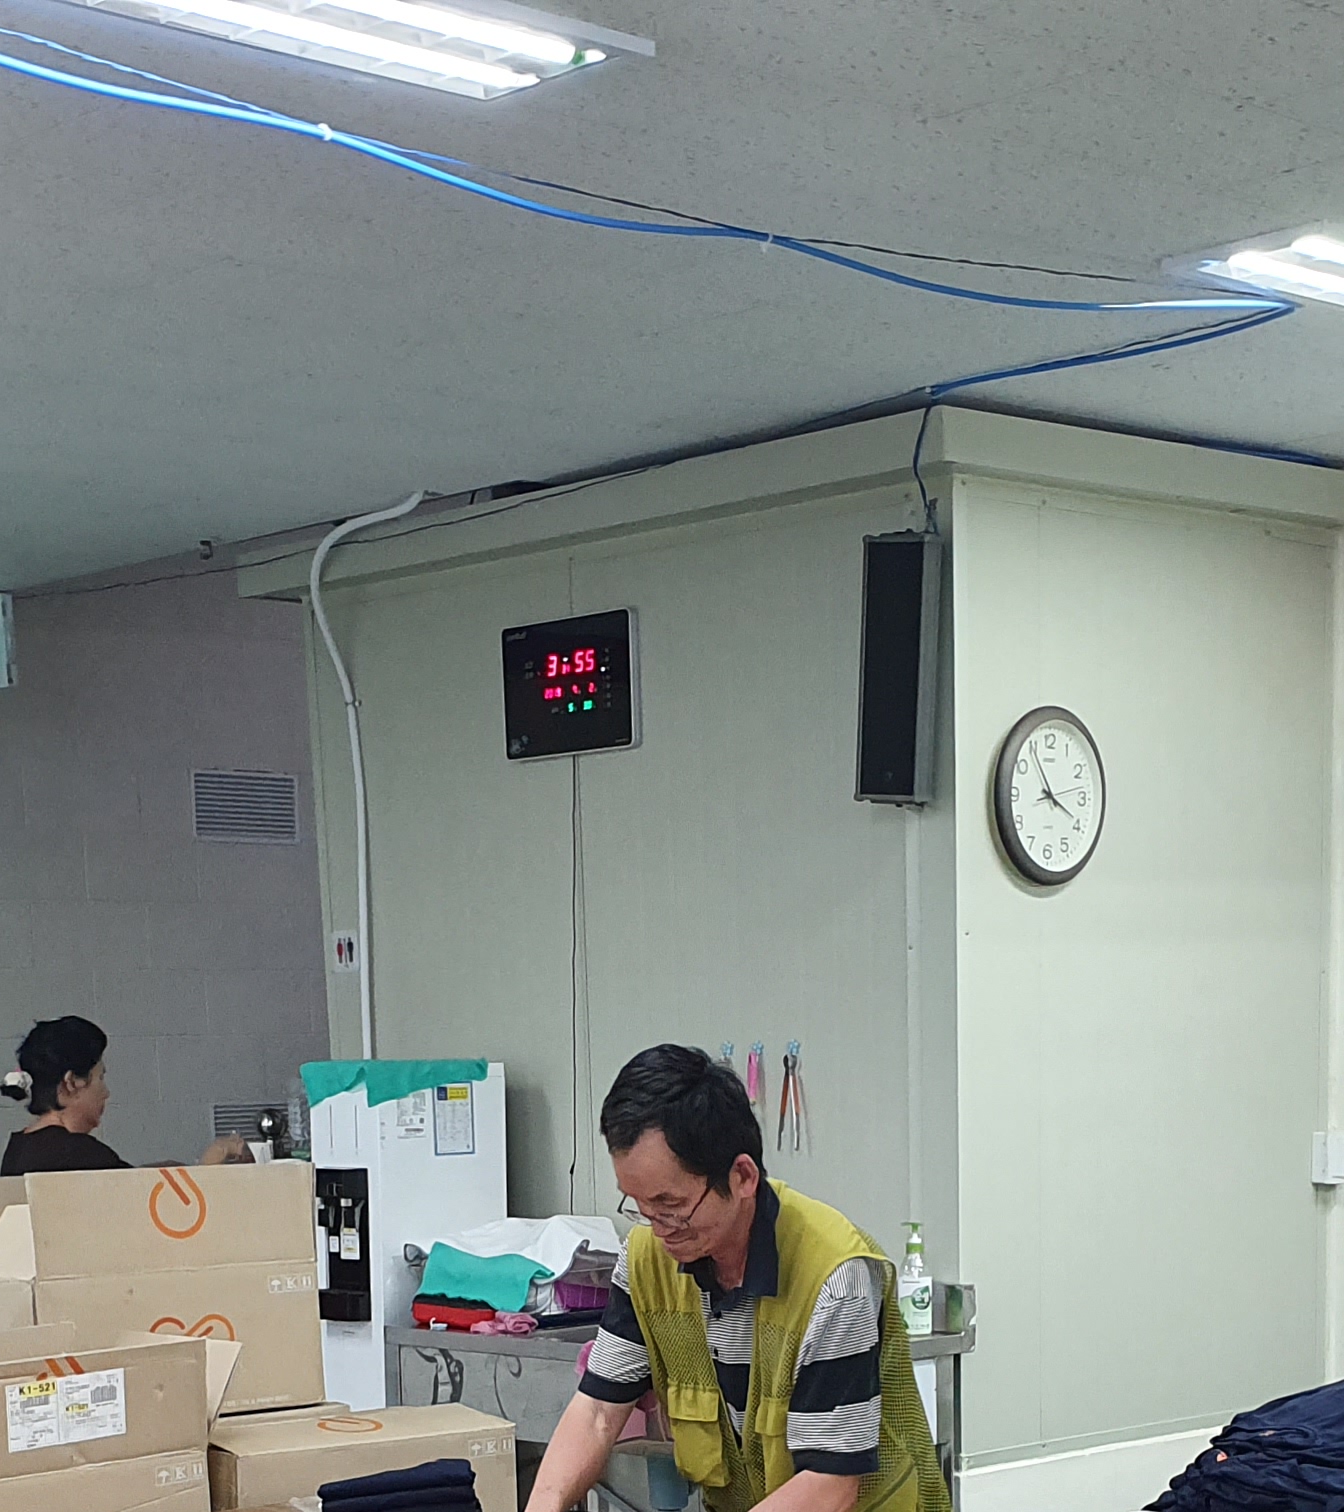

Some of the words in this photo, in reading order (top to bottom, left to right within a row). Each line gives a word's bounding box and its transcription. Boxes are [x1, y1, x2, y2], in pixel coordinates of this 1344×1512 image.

[1044, 733, 1056, 749] 12
[1073, 763, 1083, 779] 2
[1077, 791, 1087, 807] 3
[1072, 818, 1081, 833] 4
[1027, 836, 1036, 851] 7
[1060, 837, 1069, 853] 5
[1043, 844, 1053, 860] 6
